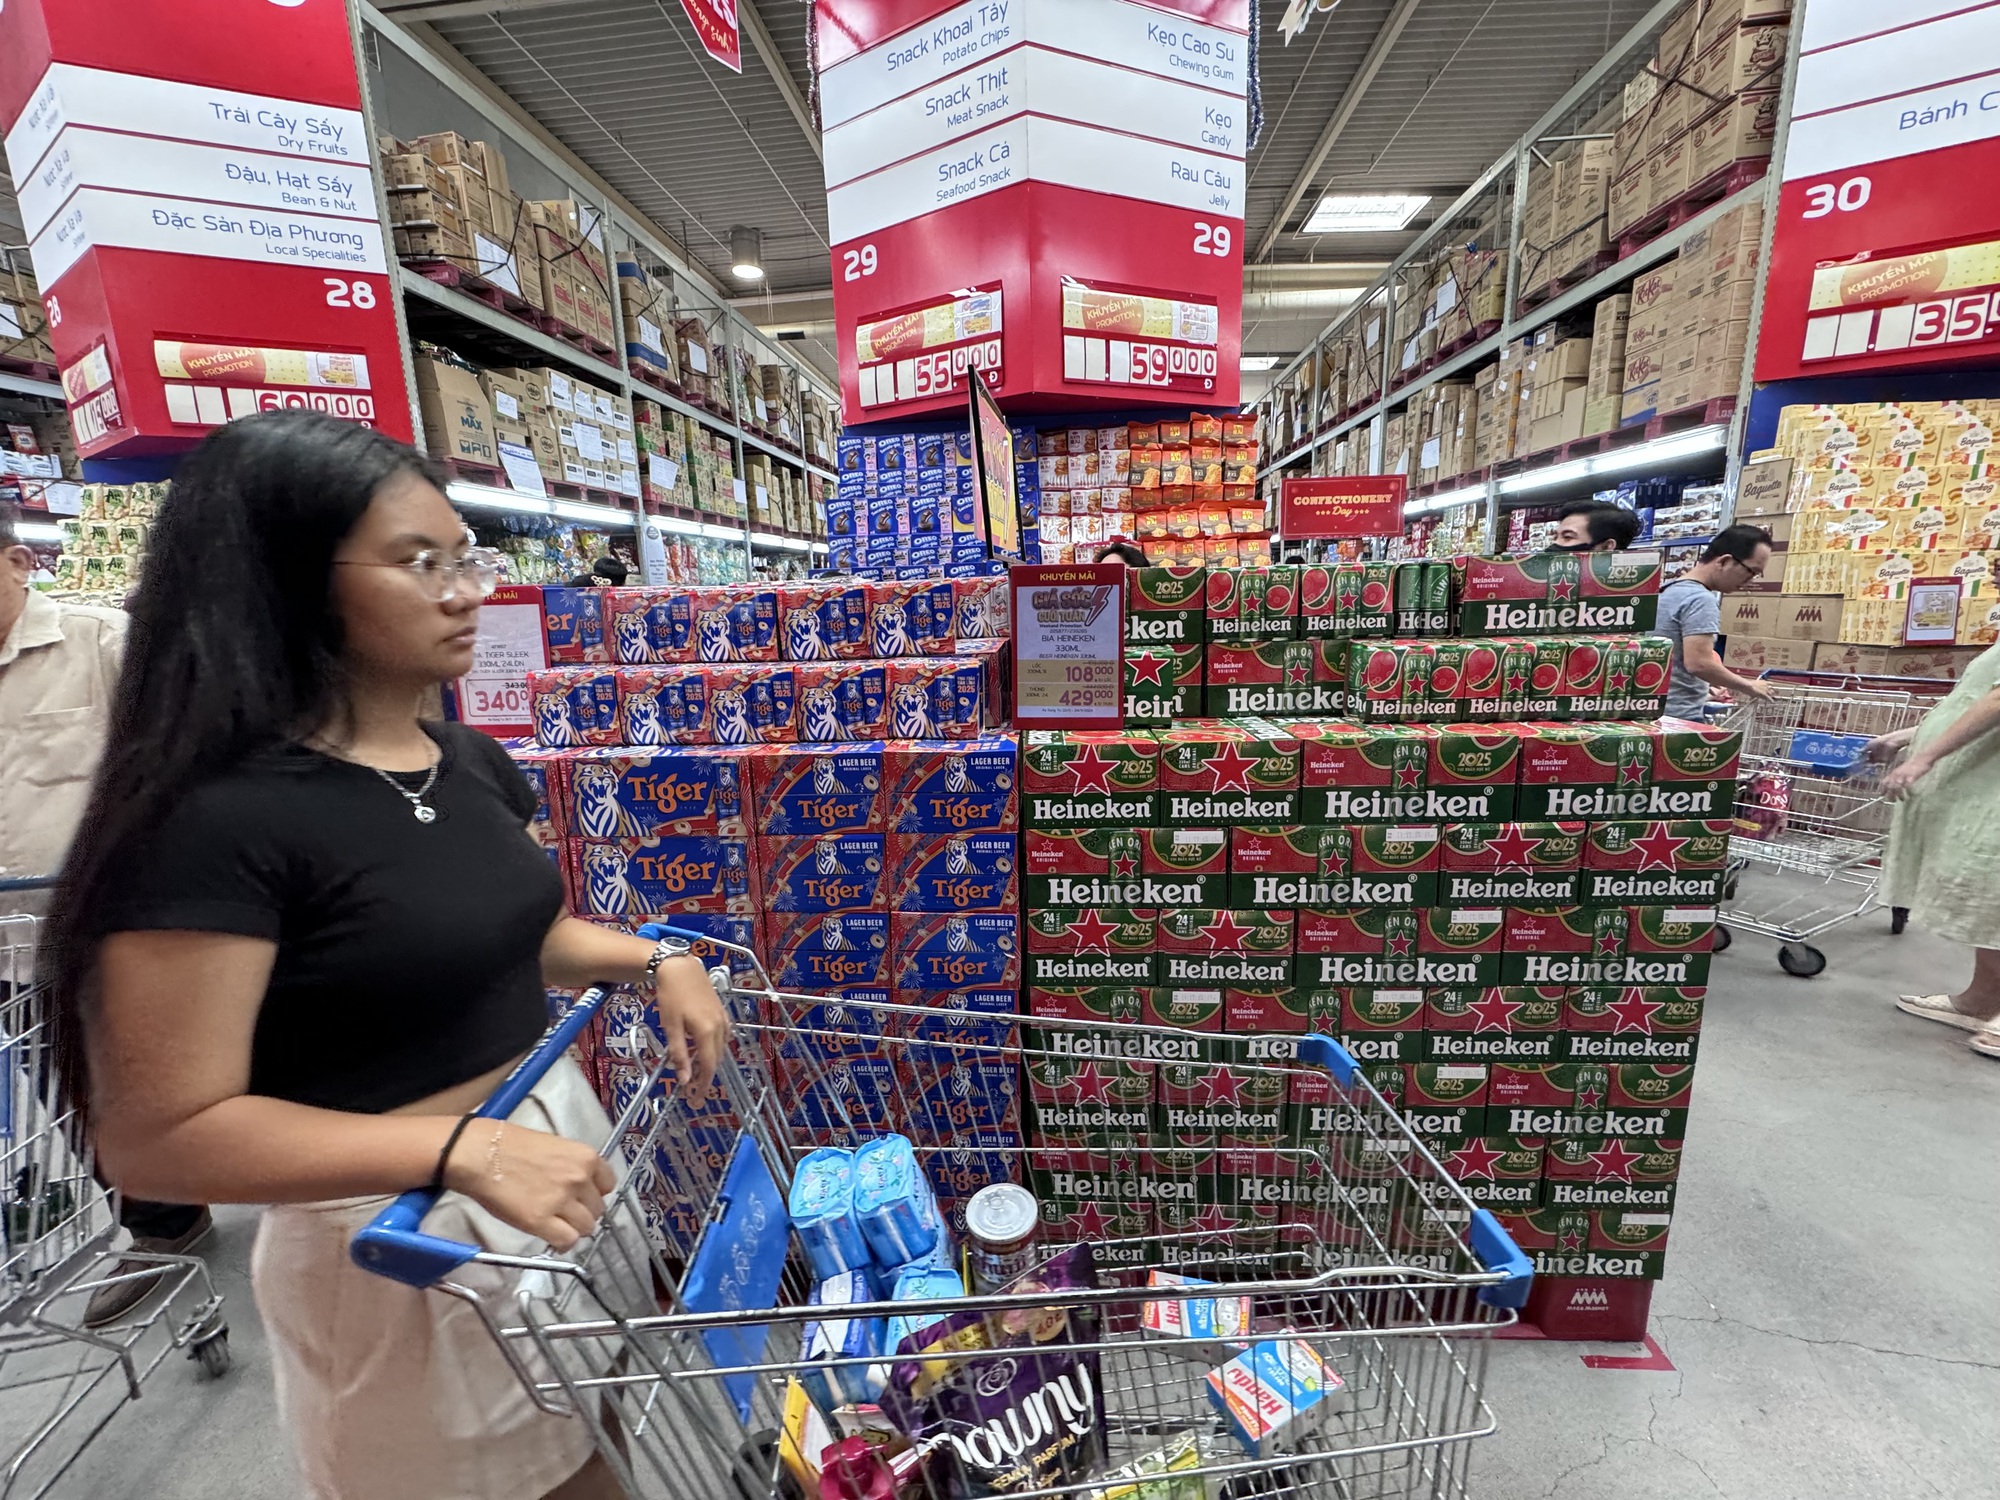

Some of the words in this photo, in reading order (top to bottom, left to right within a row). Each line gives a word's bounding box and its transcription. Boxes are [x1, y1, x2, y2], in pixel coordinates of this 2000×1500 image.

[887, 38, 929, 71] Snack
[933, 16, 973, 50] Khoai
[978, 0, 1009, 27] Tây
[943, 41, 977, 65] Potato
[981, 26, 1010, 47] Chips
[1148, 22, 1177, 47] Kẹo
[1182, 33, 1211, 55] Cao
[1216, 42, 1235, 62] Su
[1169, 54, 1210, 78] Chewing
[1213, 65, 1235, 82] Gum
[925, 84, 971, 116] Snack
[977, 67, 1008, 94] Thịt
[947, 107, 973, 128] Meat
[976, 94, 1009, 116] Snack
[1205, 107, 1232, 130] Kẹo
[1899, 99, 1968, 131] Bánh
[208, 102, 250, 124] Trái
[257, 110, 297, 135] Cây
[305, 117, 344, 142] Sấy
[278, 135, 303, 152] Dry
[308, 139, 348, 156] Fruits
[1201, 130, 1231, 150] Candy
[939, 152, 984, 182] Snack
[989, 141, 1010, 163] Cá
[277, 170, 311, 191] Hạt
[317, 175, 353, 198] Sấy
[936, 178, 976, 202] Seafood
[979, 166, 1011, 188] Snack
[1171, 161, 1199, 183] Rau
[1204, 169, 1231, 190] Câu
[281, 192, 316, 207] Bean
[320, 196, 329, 208] &
[334, 198, 358, 212] Nut
[1208, 193, 1231, 211] Jelly
[1801, 176, 1872, 219] 30
[152, 210, 196, 231] Đặc
[203, 215, 243, 234] Sản
[249, 219, 283, 240] Địa
[289, 224, 364, 250] Phương
[1193, 222, 1231, 257] 29
[265, 243, 299, 256] Local
[302, 246, 367, 263] Specialities
[843, 244, 878, 282] 29
[323, 278, 376, 310] 28
[1859, 267, 1931, 302] PROMOTION
[46, 295, 62, 328] 28
[1095, 309, 1136, 330] PROMOTION
[883, 327, 918, 356] PROMOTION
[202, 359, 255, 379] PROMOTION
[461, 416, 483, 432] MAX
[839, 438, 861, 448] OREO
[1293, 494, 1393, 506] CONFECTIONERY
[1743, 479, 1783, 500] Baguette
[912, 497, 936, 508] OREO
[1331, 505, 1352, 518] Day
[900, 568, 925, 578] OREO
[1039, 570, 1077, 582] KHUYẾN
[1078, 571, 1096, 580] MÃI
[1055, 644, 1081, 652] 330ML
[1056, 634, 1096, 642] HEINEKEN
[484, 651, 505, 659] TIGER
[1065, 665, 1094, 683] 108
[1094, 666, 1114, 675] 000
[475, 690, 520, 712] 340
[1058, 689, 1094, 706] 429
[1094, 690, 1114, 699] 000
[838, 758, 859, 767] LAGER
[859, 758, 877, 766] BEER
[970, 757, 992, 766] LAGER
[993, 757, 1011, 766] BEER
[1040, 749, 1052, 762] 24
[1178, 747, 1191, 760] 24
[627, 772, 707, 813] Tiger
[930, 797, 992, 827] Tiger
[1460, 827, 1473, 841] 24
[1607, 826, 1619, 840] 24
[636, 853, 716, 893] Tiger
[804, 878, 864, 907] Tiger
[846, 918, 867, 927] LAGER
[867, 919, 884, 927] BEER
[809, 955, 868, 984] Tiger
[974, 994, 994, 1003] LAGER
[994, 994, 1012, 1003] BEER
[931, 1100, 989, 1125] Tiger
